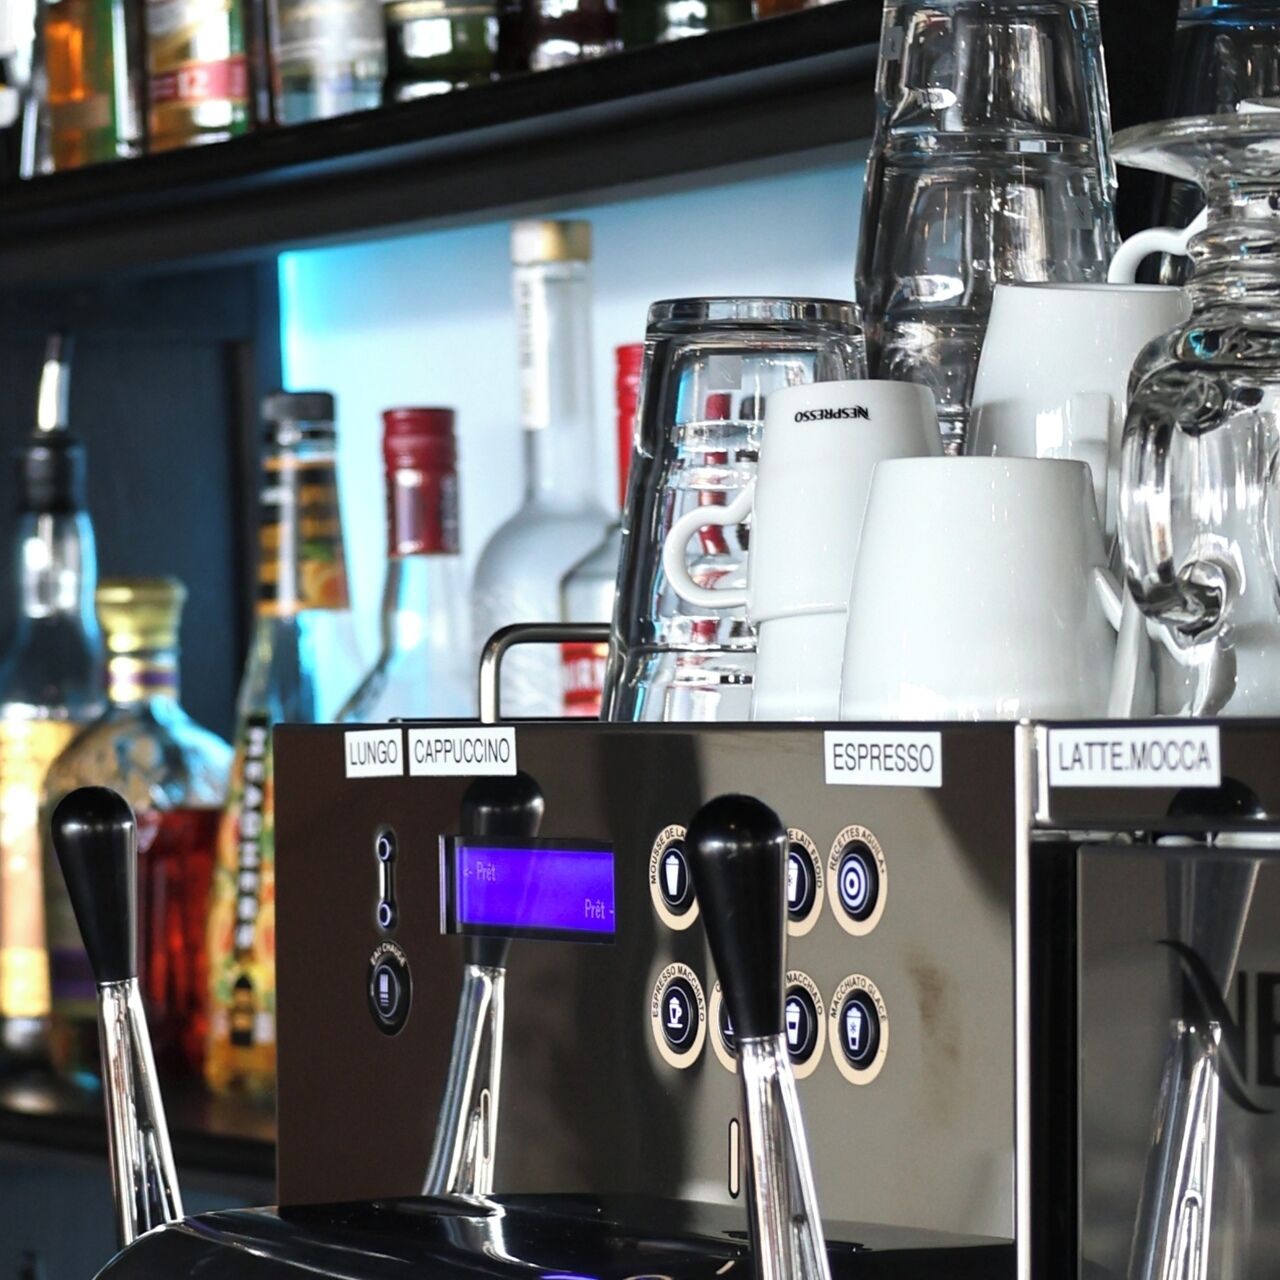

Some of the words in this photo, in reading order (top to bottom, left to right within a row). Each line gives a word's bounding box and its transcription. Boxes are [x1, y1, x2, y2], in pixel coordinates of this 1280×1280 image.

[794, 405, 871, 422] NESPRESSO
[350, 739, 398, 766] LUNGO
[414, 737, 510, 764] CAPPUCCINO
[832, 742, 935, 773] ESPRESSO
[1058, 740, 1212, 772] LATTE.MOCCA
[650, 834, 666, 885] MOUSSE
[665, 827, 675, 840] DE
[795, 831, 812, 849] LAIT
[810, 848, 823, 889] FROID
[829, 827, 860, 871] RECETTES
[477, 861, 496, 882] Prêt
[585, 898, 606, 920] Prêt
[652, 965, 676, 1018] ESPRESSO
[677, 965, 705, 1022] MACCHIATO
[786, 972, 823, 1016] MACCHIATO
[830, 976, 866, 1019] MACCHIATO
